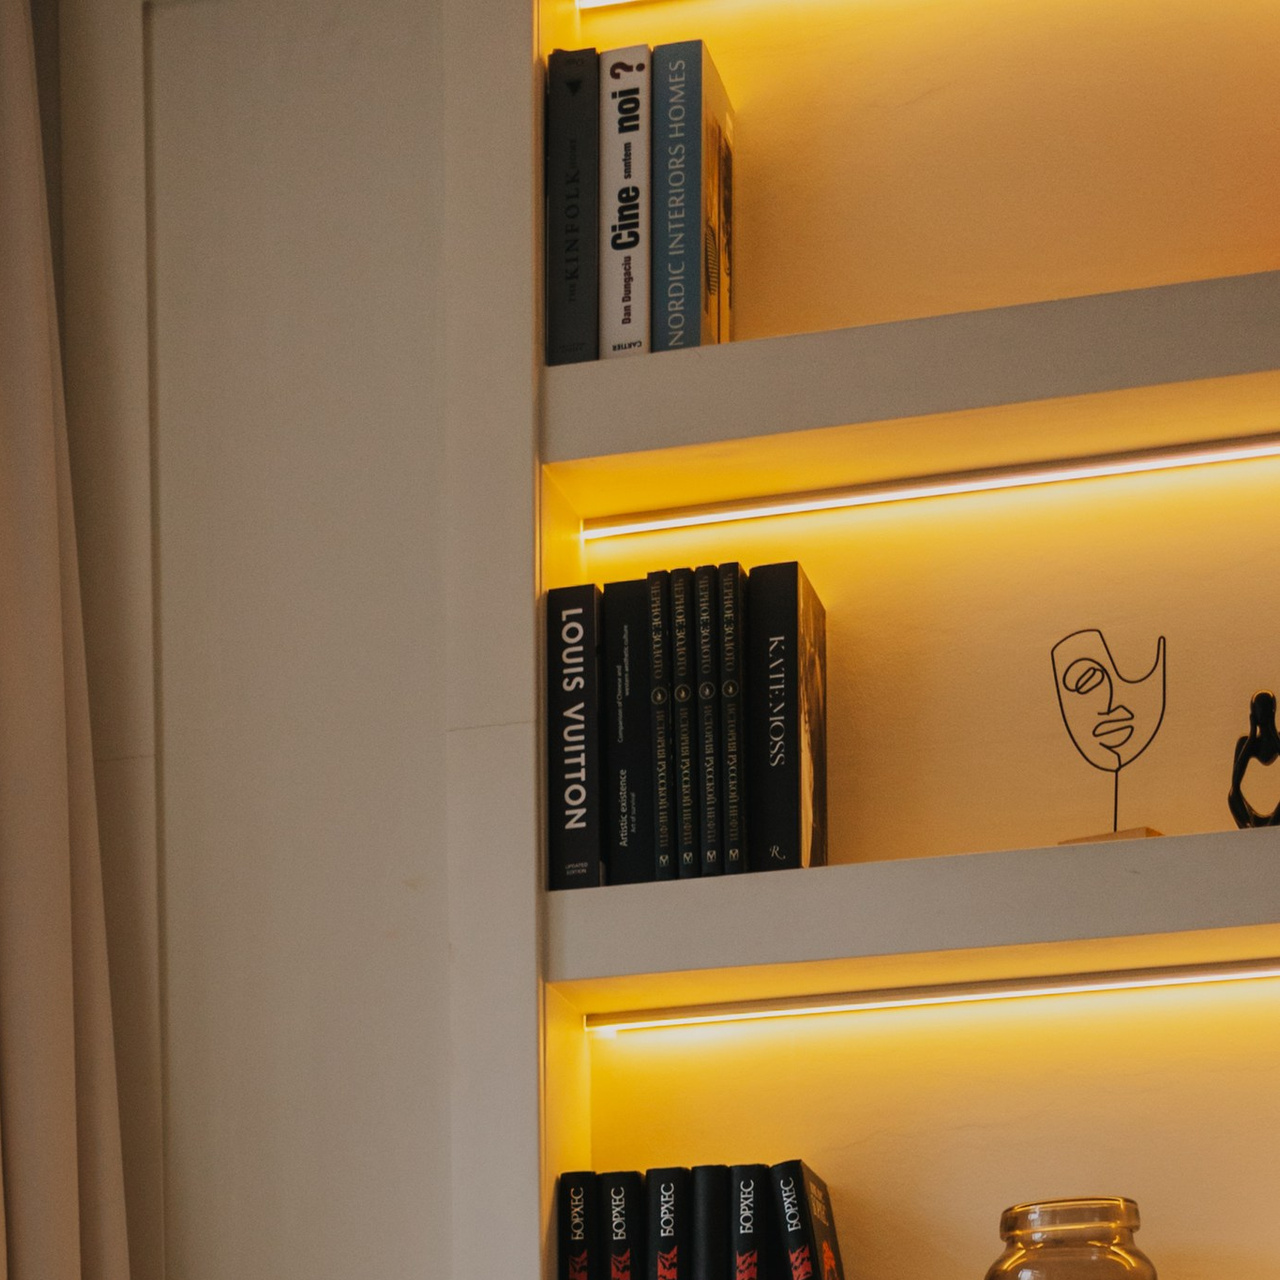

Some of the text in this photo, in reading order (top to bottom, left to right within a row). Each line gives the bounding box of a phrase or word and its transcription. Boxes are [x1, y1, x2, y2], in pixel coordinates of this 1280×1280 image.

[611, 87, 640, 134] noi
[565, 169, 580, 282] KINFOLK
[611, 186, 640, 251] Cine
[668, 59, 685, 347] NORDIC INTERIORS HOMES
[622, 255, 633, 302] Dungaciu
[622, 304, 632, 324] Dan
[650, 581, 663, 679] ЧЕРНОЕ ЗОЛОТО
[674, 578, 687, 676] ЧЕРНОЕ ЗОЛОТО
[698, 576, 711, 674] ЧЕРНОЕ ЗОЛОТО
[723, 573, 735, 672] ЧЕРНОЕ ЗОЛОТО
[561, 608, 587, 830] LOUIS VUITTON
[768, 635, 785, 767] KATE MOSS
[657, 761, 670, 809] РУССКОЙ
[680, 758, 693, 806] РУССКОЙ
[705, 756, 717, 805] РУССКОЙ
[727, 754, 740, 803] РУССКОЙ
[619, 769, 628, 847] Artistic existence
[571, 1187, 585, 1241] БОРХЕС
[611, 1186, 626, 1240] БОРХЕС
[660, 1182, 675, 1237] БОРХЕС
[740, 1179, 755, 1234] БОРХЕС
[780, 1177, 802, 1232] БОРХЕС
